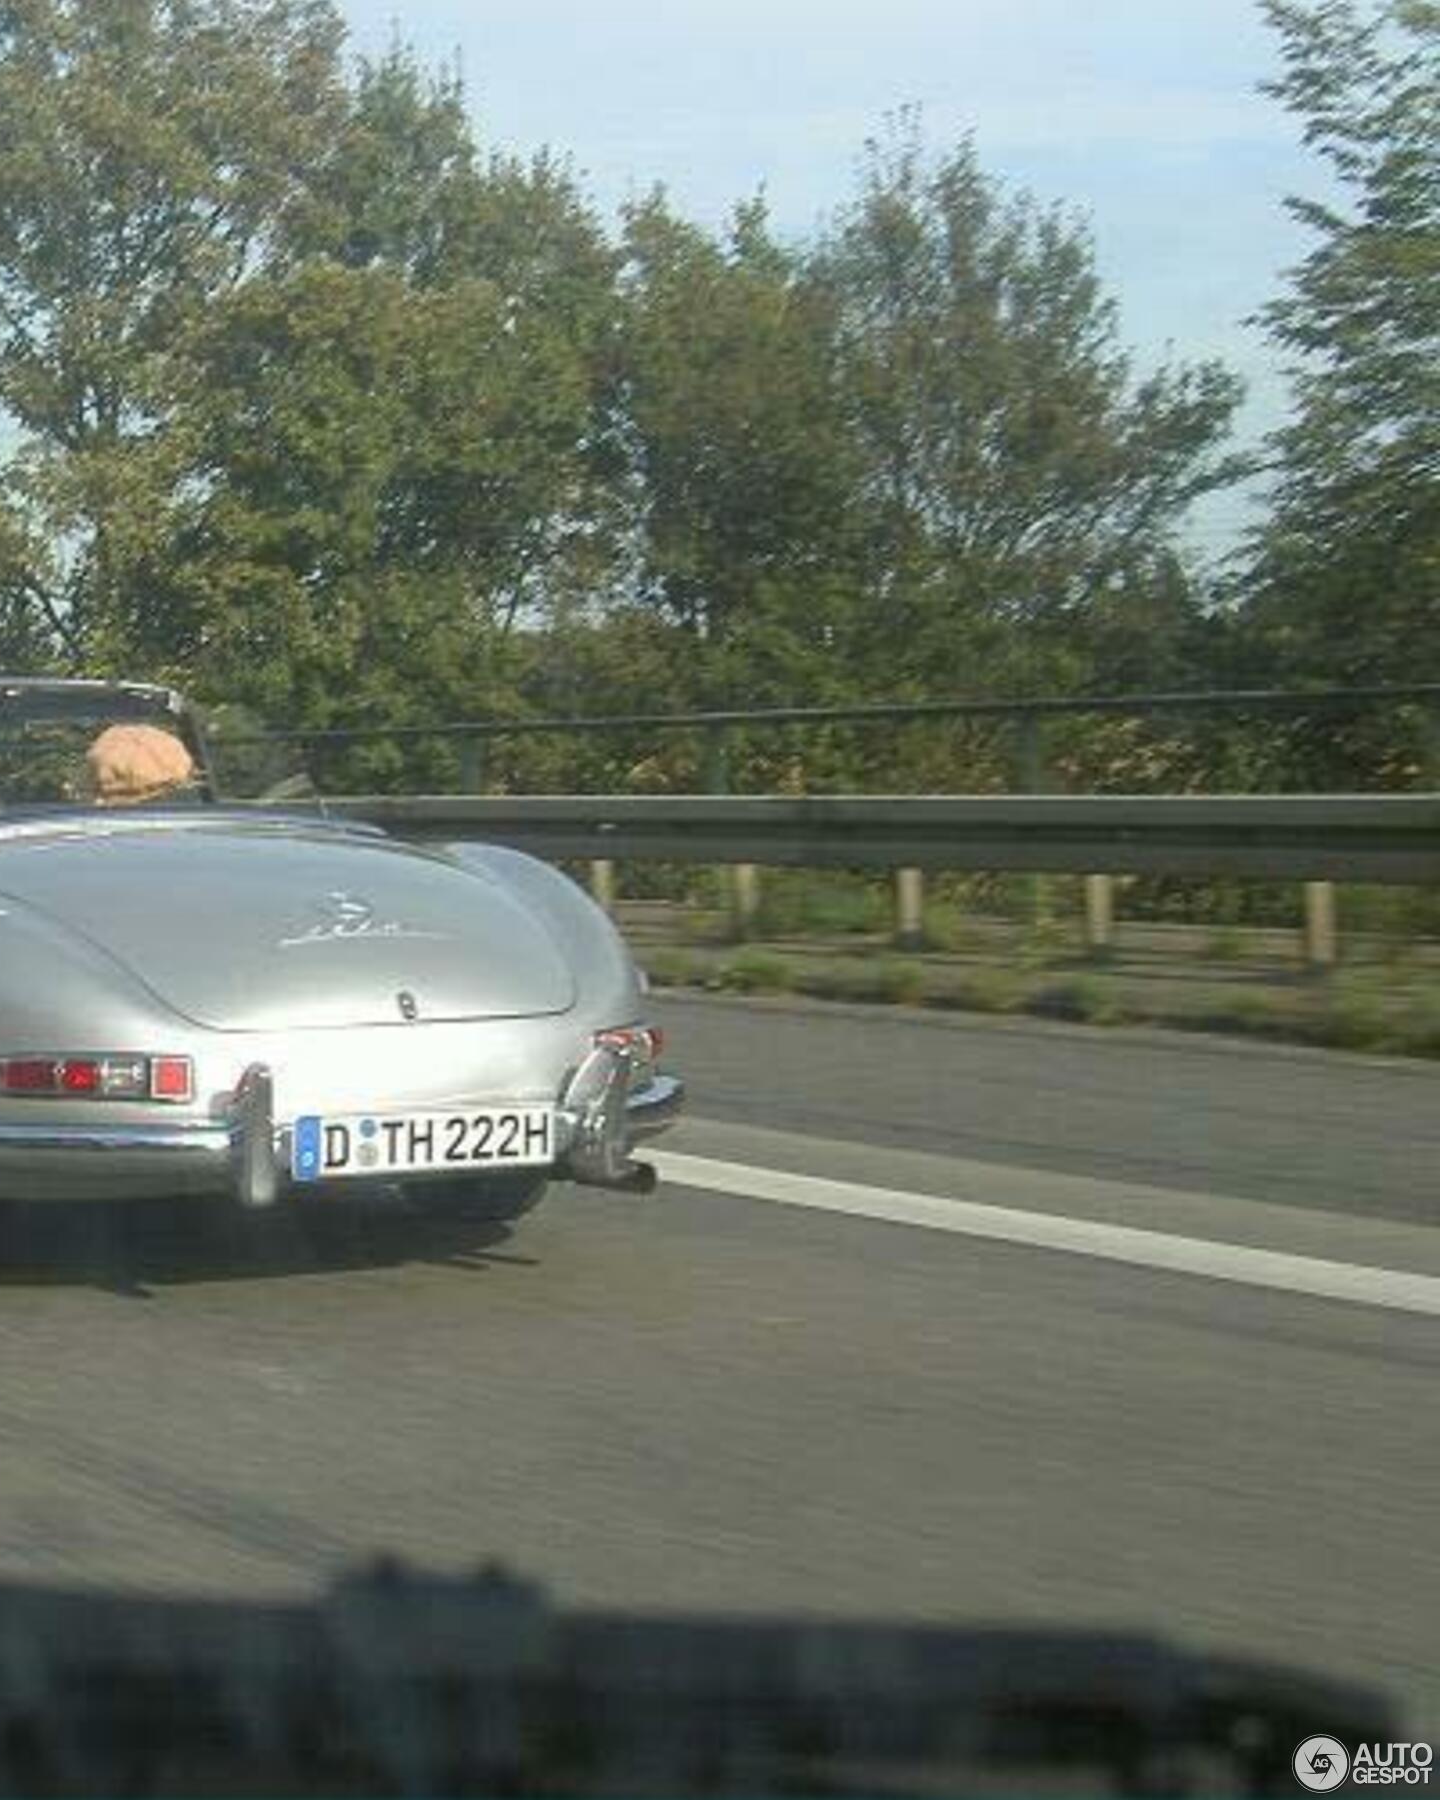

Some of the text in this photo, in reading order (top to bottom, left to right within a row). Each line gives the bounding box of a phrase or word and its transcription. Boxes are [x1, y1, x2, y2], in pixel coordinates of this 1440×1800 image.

[325, 1113, 549, 1167] D TH 222H
